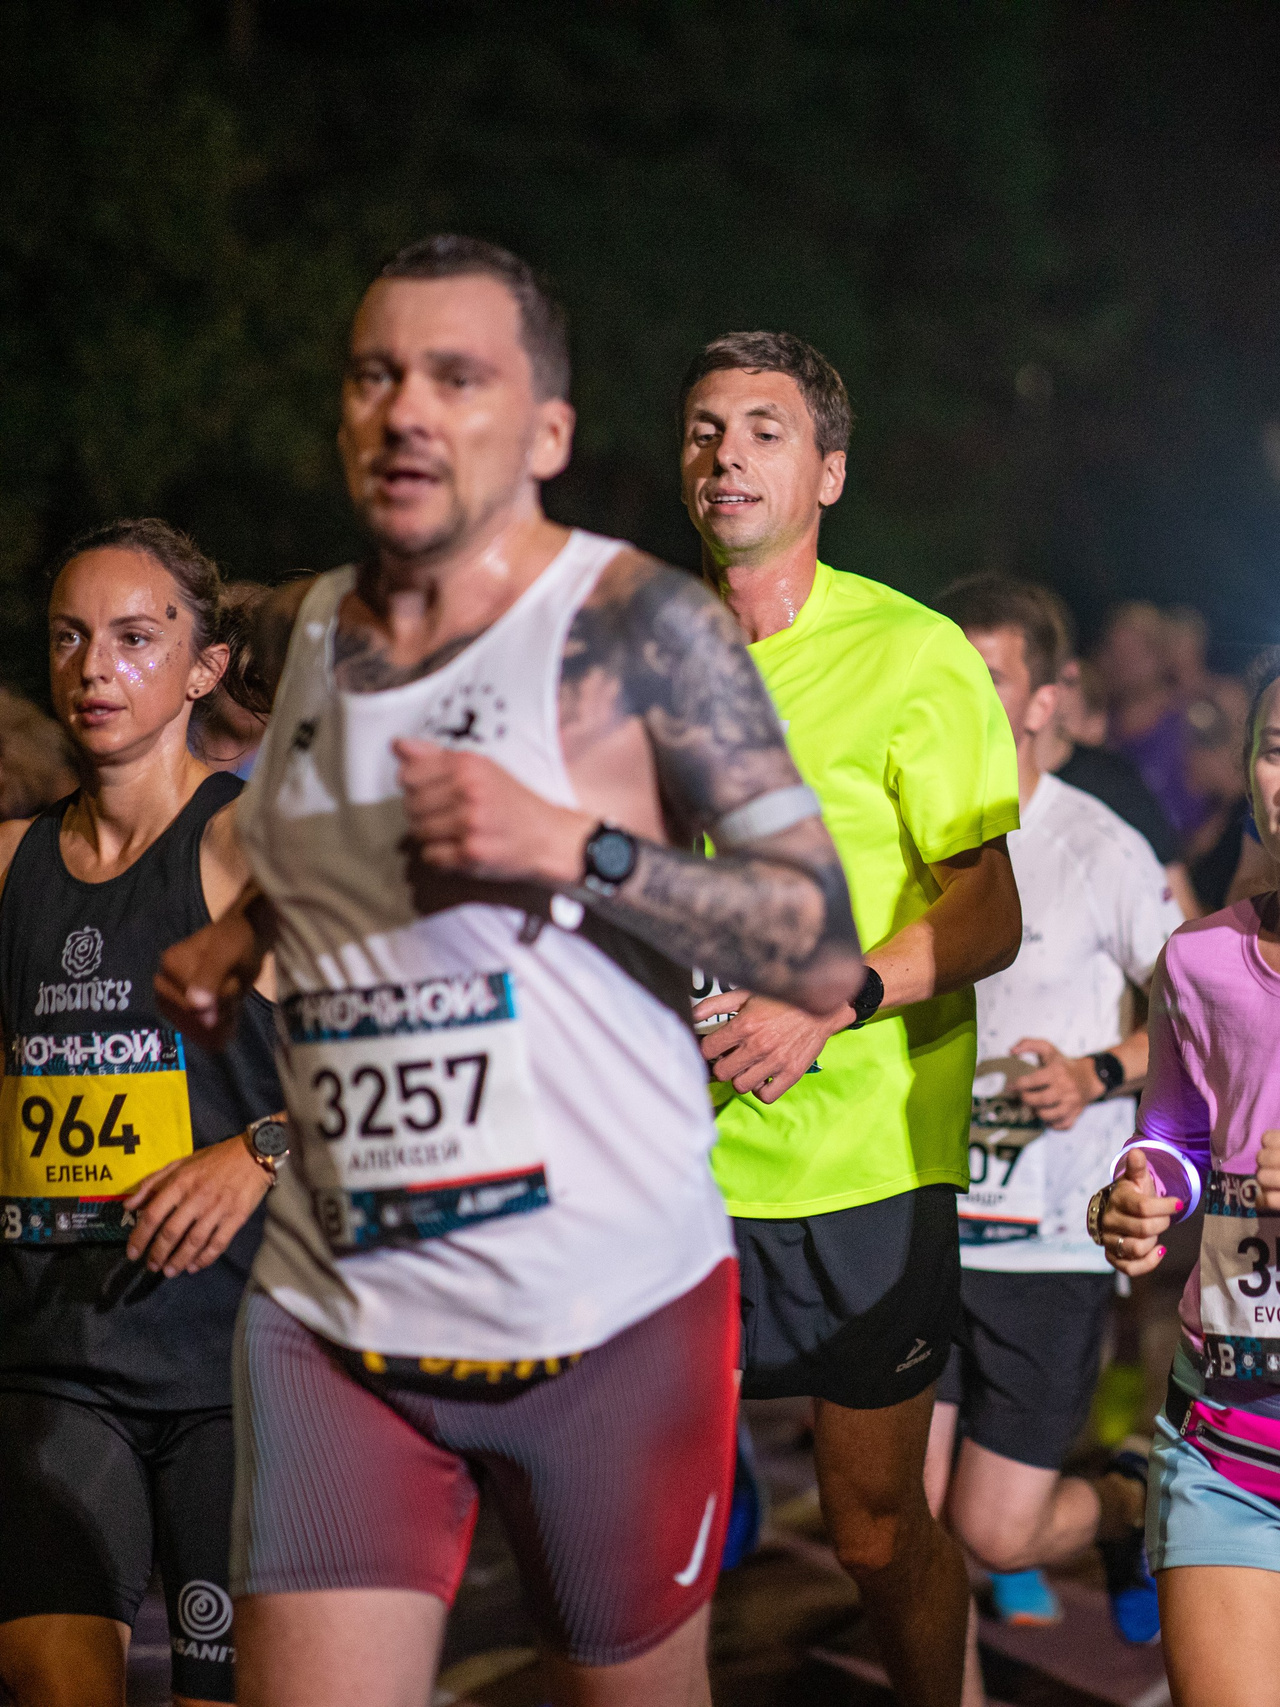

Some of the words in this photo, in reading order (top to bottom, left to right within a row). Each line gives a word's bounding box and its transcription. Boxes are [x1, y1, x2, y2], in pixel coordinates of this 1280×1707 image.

[34, 976, 132, 1016] insanity
[312, 1052, 489, 1141] 3257
[21, 1093, 141, 1158] 964
[45, 1164, 114, 1183] ЕЛЕНА
